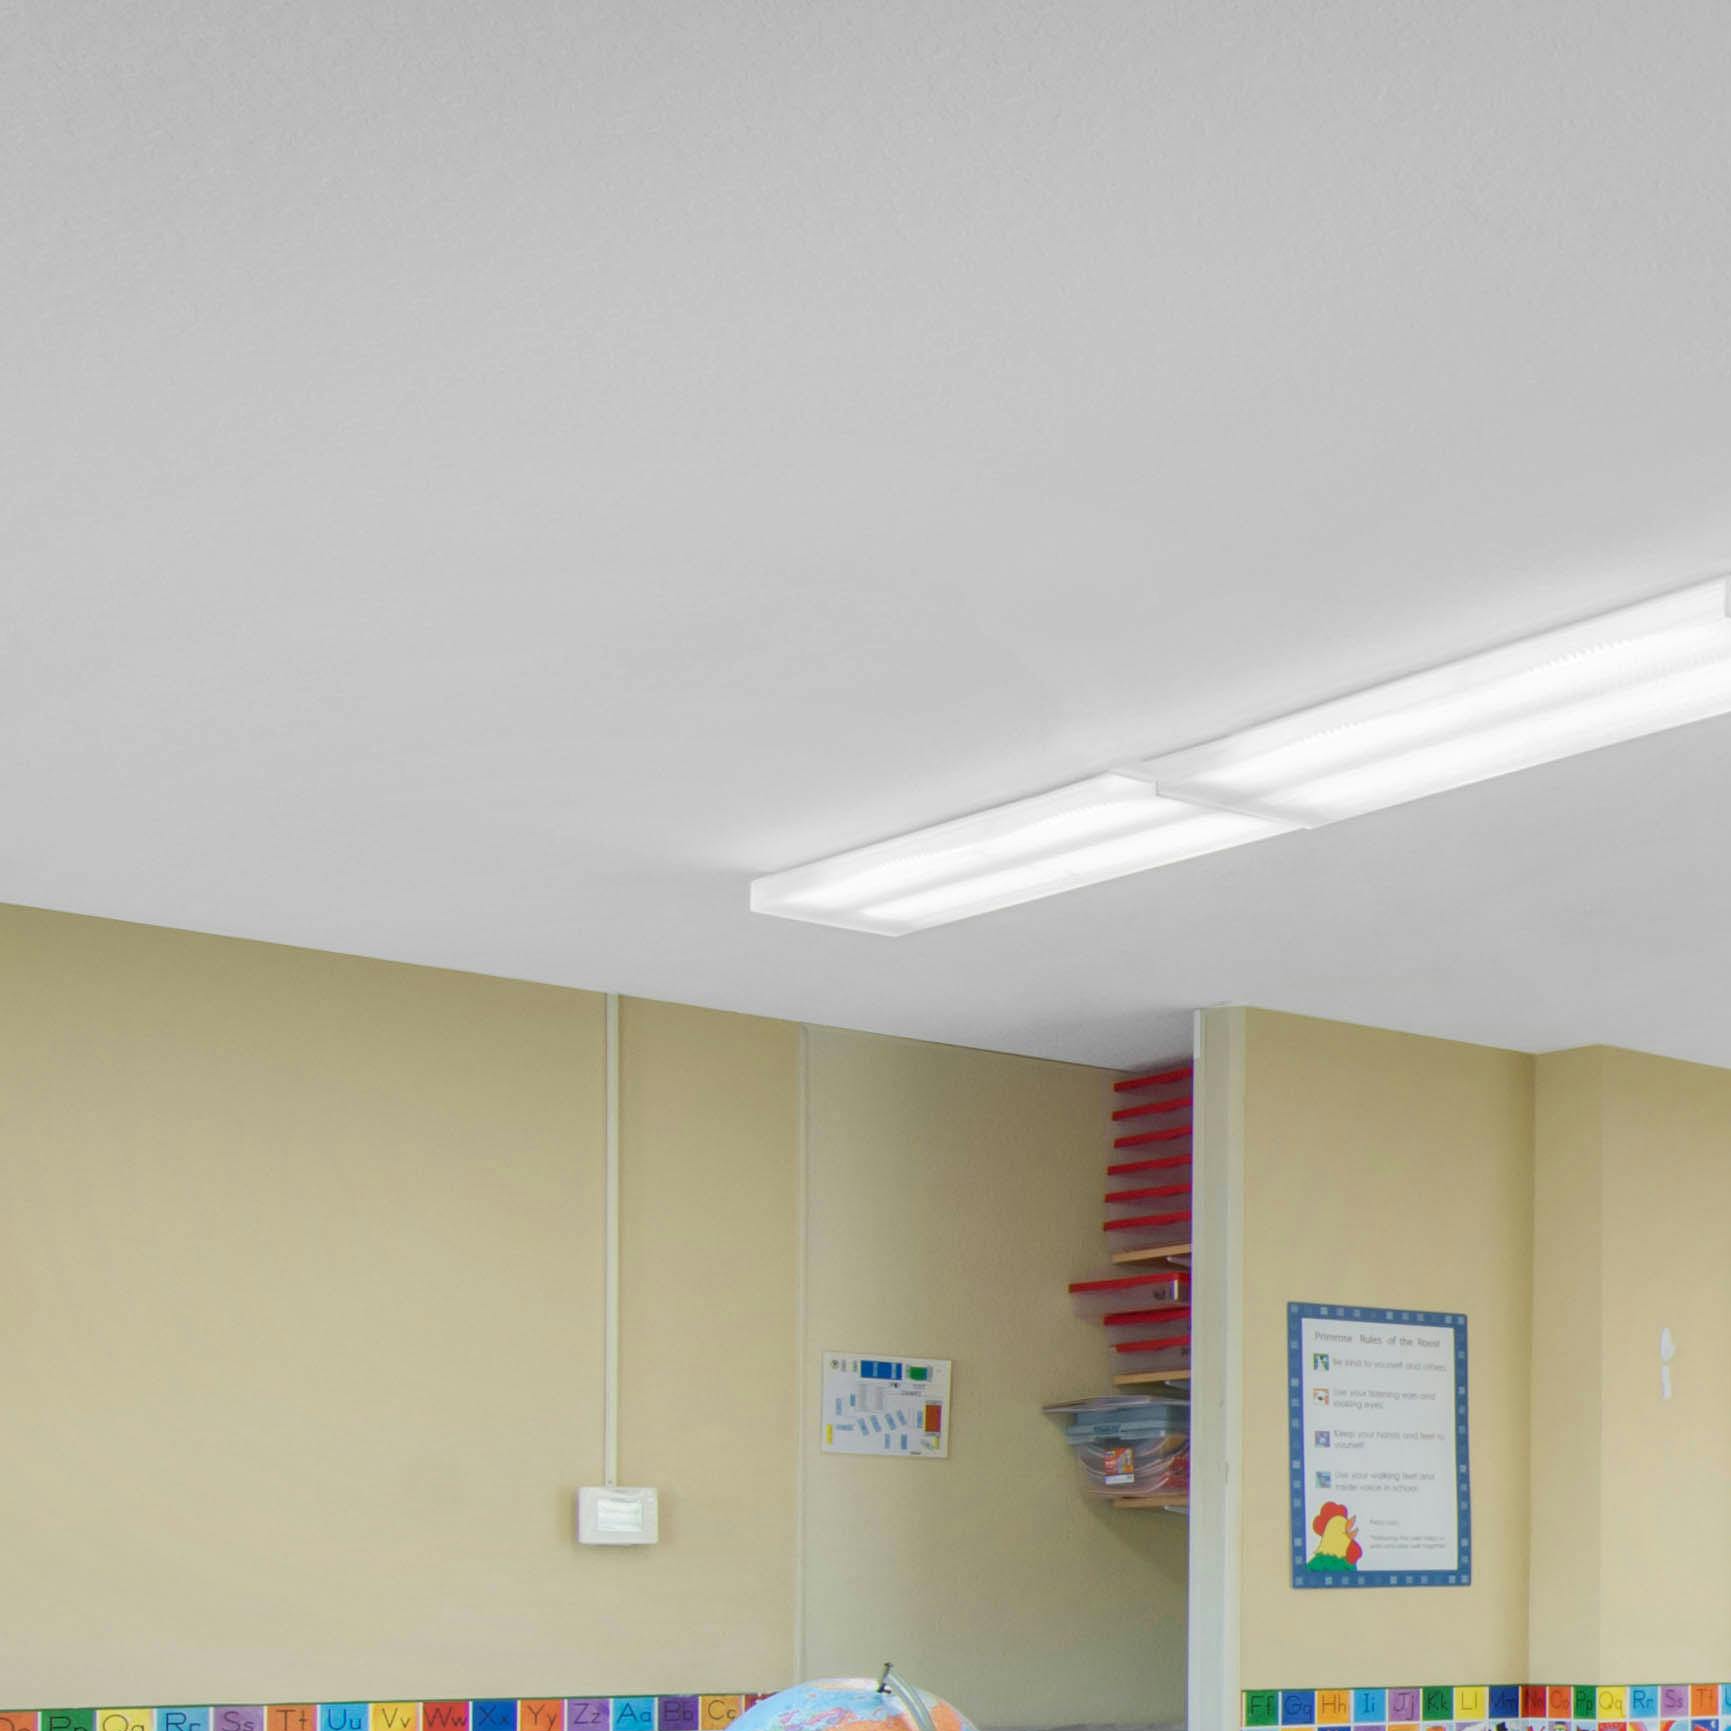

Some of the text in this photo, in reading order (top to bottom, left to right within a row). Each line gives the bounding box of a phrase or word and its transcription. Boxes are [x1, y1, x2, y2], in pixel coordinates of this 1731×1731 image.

[276, 1709, 310, 1731] Tt
[327, 1708, 362, 1731] Uu
[381, 1707, 411, 1729] Vv
[422, 1706, 467, 1729] Ww
[478, 1705, 509, 1726] Xx
[572, 1703, 601, 1725] Zz
[616, 1703, 651, 1724] Aa
[663, 1701, 694, 1723] Bb
[706, 1699, 738, 1721] Cc
[1250, 1695, 1273, 1717] Ff
[1320, 1693, 1347, 1714] Hh
[1599, 1690, 1626, 1718] Qq
[1664, 1688, 1684, 1709] Ss
